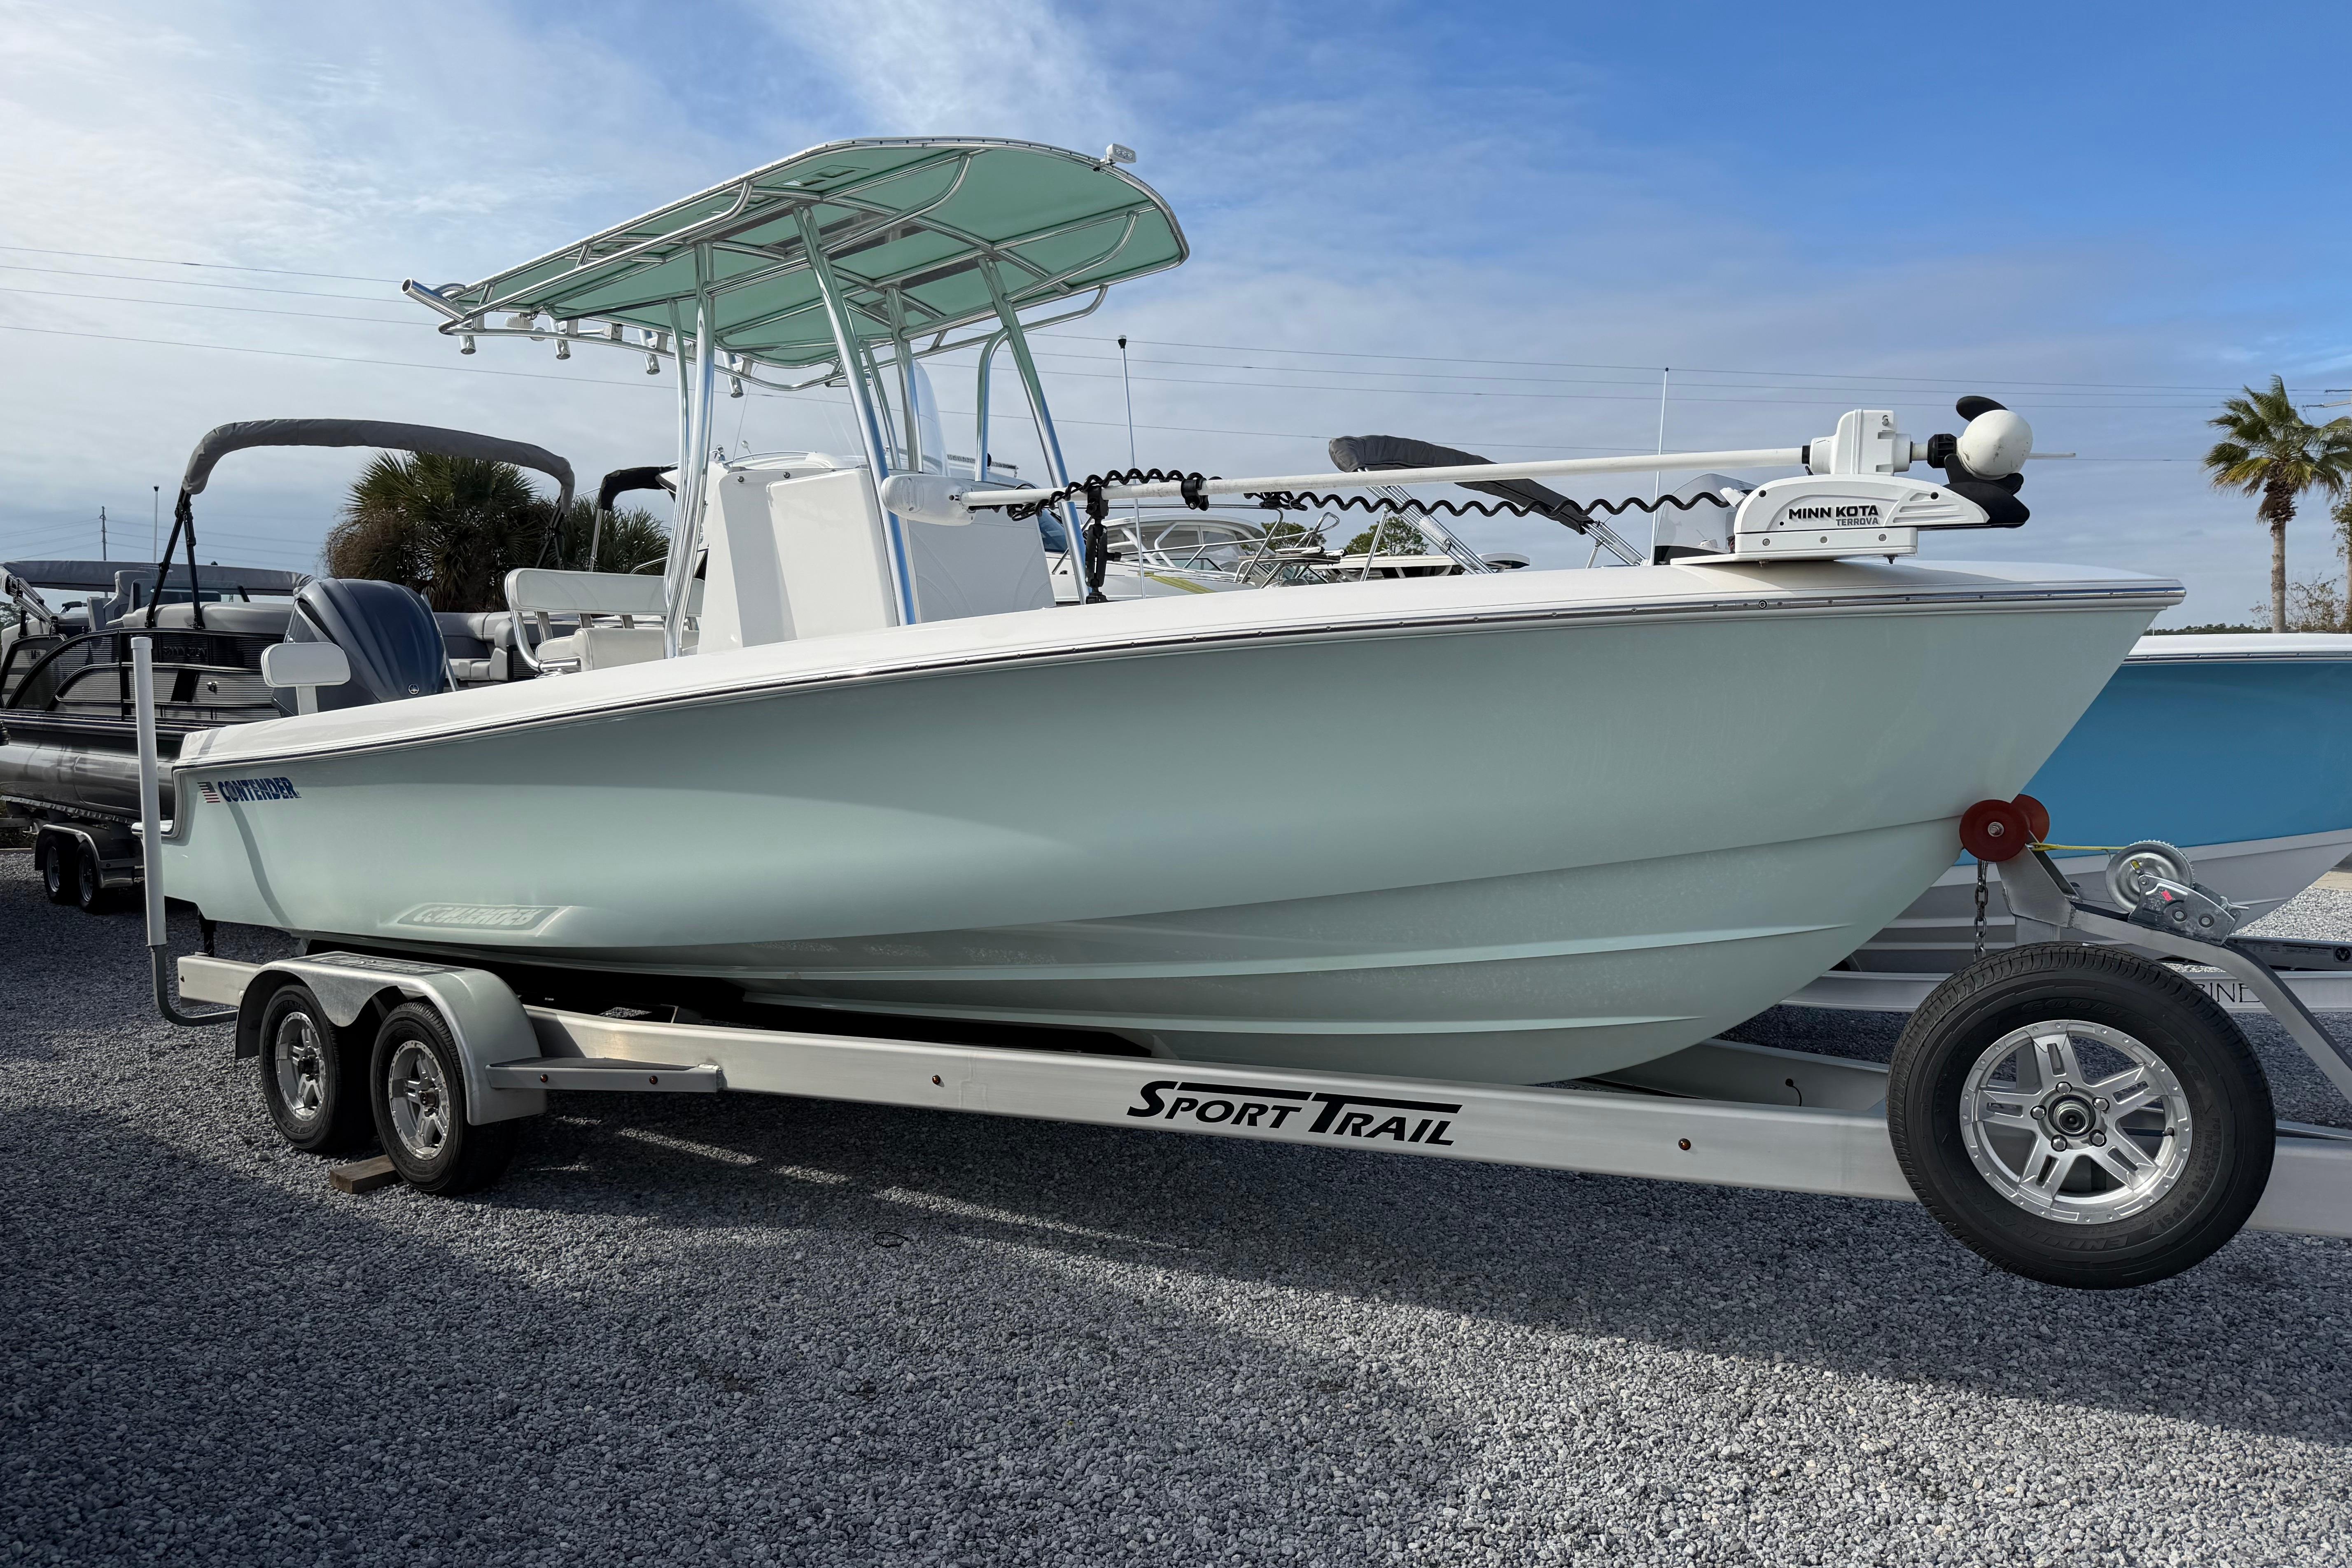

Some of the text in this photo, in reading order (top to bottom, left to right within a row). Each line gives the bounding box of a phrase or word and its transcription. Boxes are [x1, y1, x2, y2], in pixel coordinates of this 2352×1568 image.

[1789, 505, 1878, 520] MINN KOTA
[1836, 518, 1878, 526] TERROVA
[217, 777, 301, 803] CONTENDER
[1127, 1080, 1463, 1146] SPORT TRAIL
